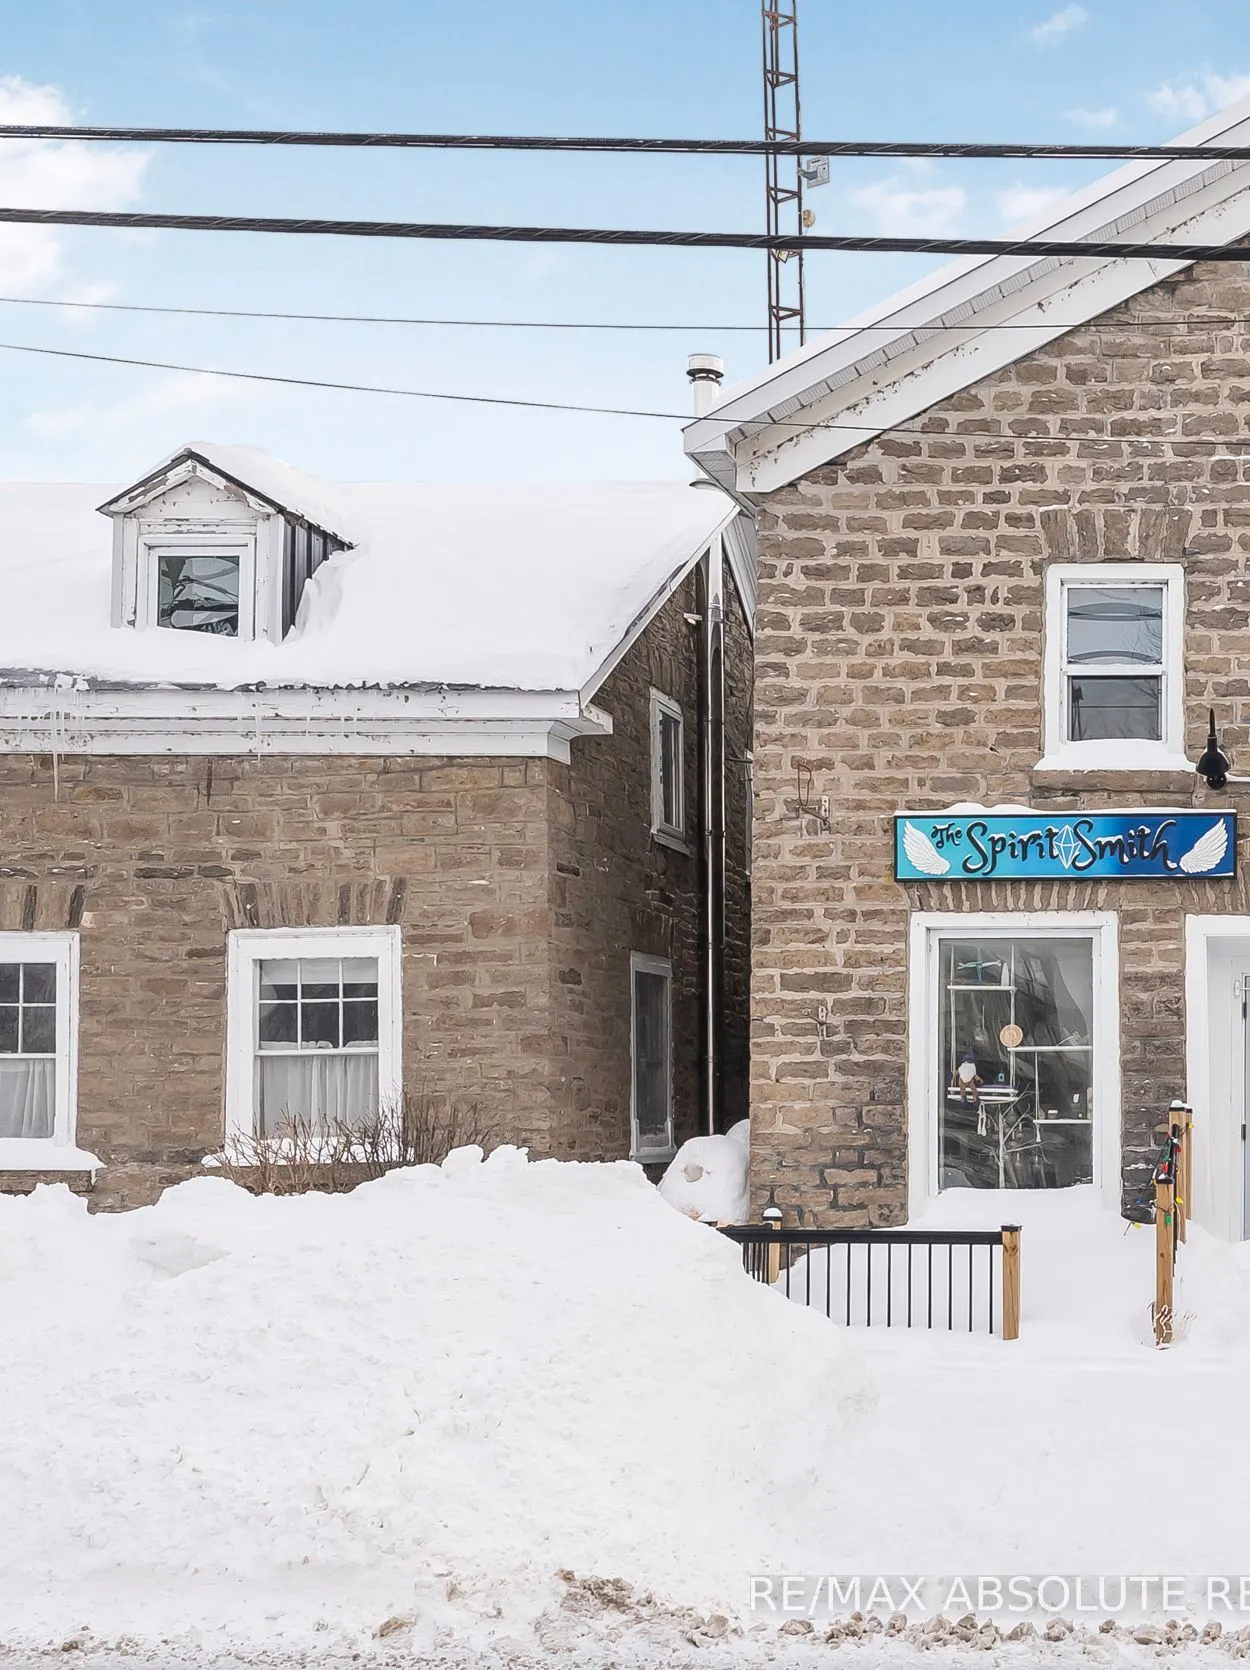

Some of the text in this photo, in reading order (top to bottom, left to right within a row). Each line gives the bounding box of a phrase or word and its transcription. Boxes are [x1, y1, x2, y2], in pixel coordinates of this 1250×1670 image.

[931, 819, 1178, 876] The Spirit Smith
